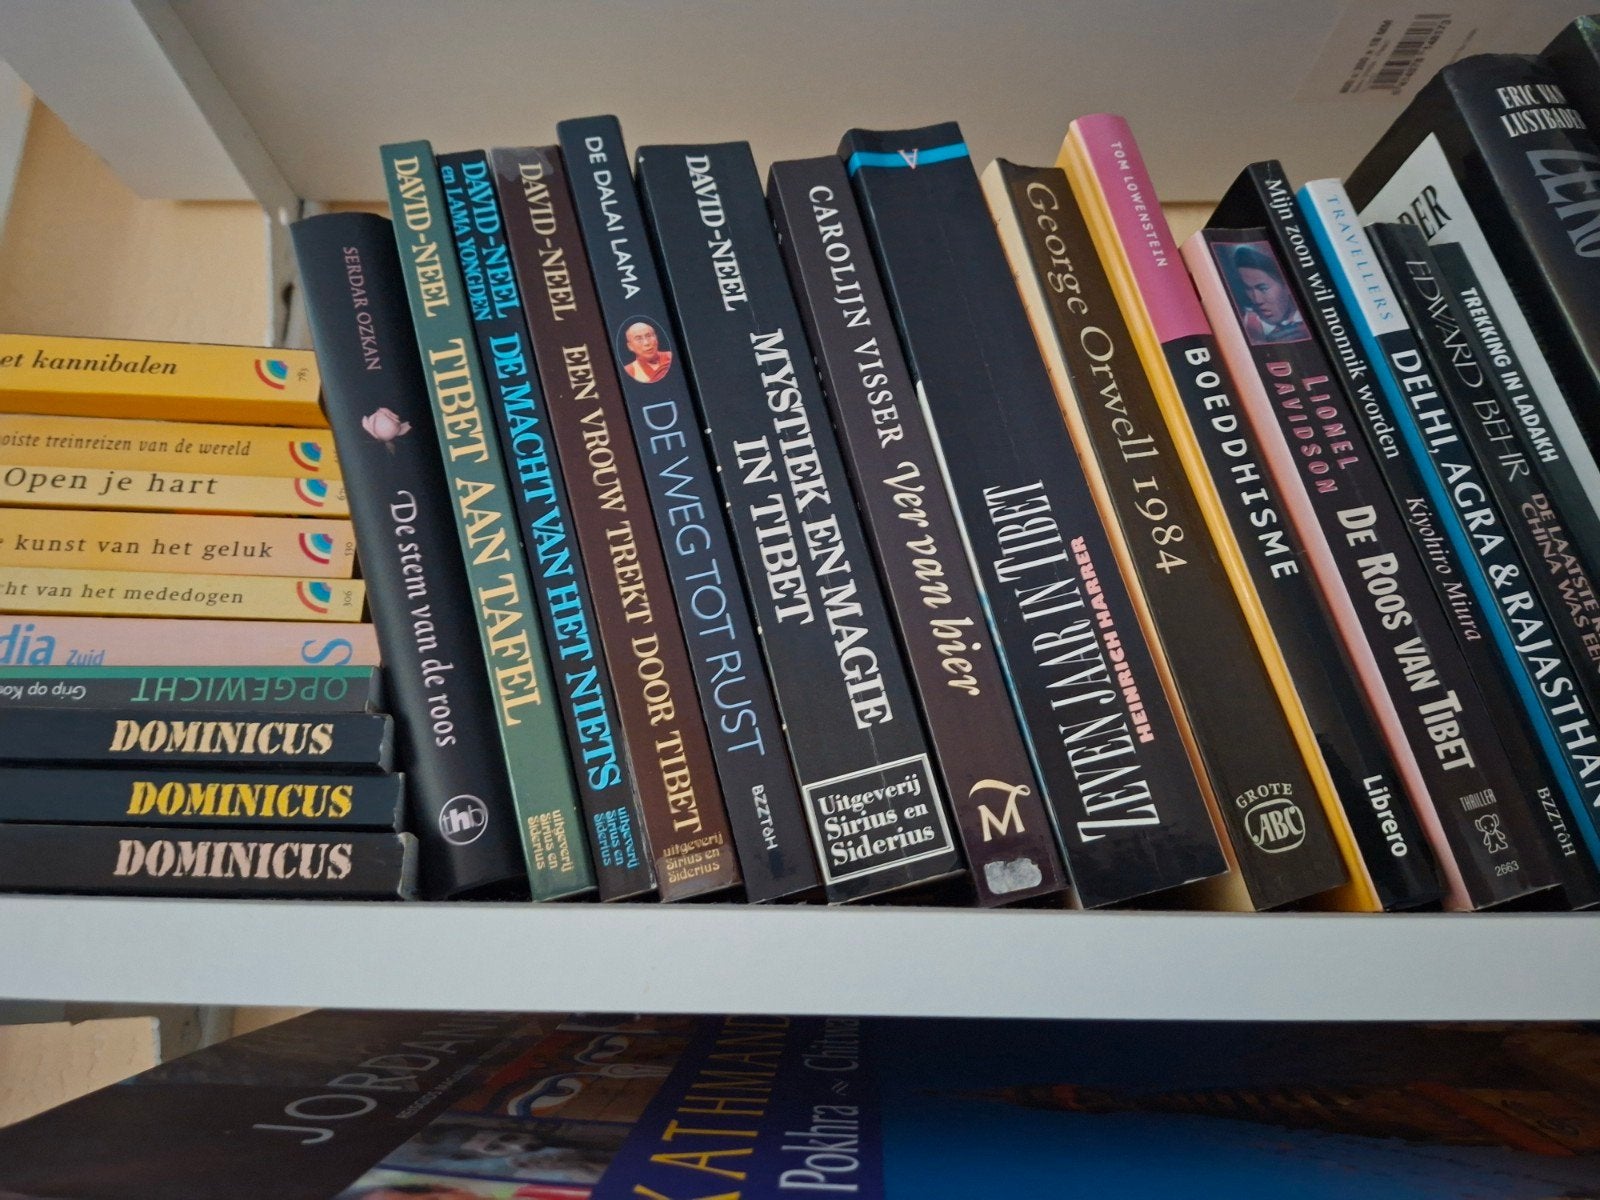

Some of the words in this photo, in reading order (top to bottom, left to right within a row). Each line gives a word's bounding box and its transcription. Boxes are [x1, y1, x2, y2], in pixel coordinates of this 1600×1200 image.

[1496, 84, 1541, 110] ERIC
[441, 166, 454, 185] en
[585, 136, 607, 164] DE
[446, 189, 470, 235] LAMA
[593, 170, 625, 233] DALAI
[685, 154, 748, 312] DAVID-NEEL
[1110, 140, 1130, 171] TOM
[1124, 175, 1167, 267] LOWENSTEIN
[393, 156, 450, 318] DAVID-NEEL
[462, 160, 520, 319] DAVID-NEEL
[518, 162, 577, 321] DAVID-NEEL
[610, 238, 641, 300] LAMA
[1325, 193, 1394, 322] TRAVELLERS
[343, 247, 368, 307] SERDAR
[356, 312, 382, 370] OZKAN
[459, 237, 493, 322] YONGDEN
[808, 185, 871, 328] CAROLIJN
[854, 337, 904, 449] VISSER
[1265, 178, 1293, 221] Mijn
[1286, 224, 1315, 268] zoon
[1307, 270, 1334, 309] wil
[1321, 306, 1365, 381] monnik
[1356, 385, 1400, 460] worden
[1460, 287, 1512, 368] TREKKING
[32, 350, 178, 375] kannibalen
[489, 332, 528, 379] DE
[562, 343, 599, 400] EEN
[1026, 182, 1090, 316] George
[1080, 325, 1160, 463] Orwell
[1132, 475, 1188, 575] 1984
[1406, 260, 1484, 389] EDWARD
[1473, 399, 1530, 482] BEHR
[1500, 370, 1524, 393] IN
[429, 339, 490, 463] TIBET
[642, 400, 686, 455] DE
[750, 328, 831, 513] MYSTIEK
[1266, 361, 1338, 494] DAVIDSON
[1302, 374, 1359, 470] LIONEL
[1511, 393, 1560, 463] LADAKH
[45, 433, 132, 452] treinreizen
[139, 440, 168, 454] van
[174, 438, 193, 454] de
[199, 441, 251, 457] wereld
[501, 382, 556, 503] MACHT
[580, 406, 627, 513] VROUW
[733, 435, 778, 485] IN
[1185, 347, 1299, 579] BOEDDHISME
[1391, 349, 1458, 455] DELHI,
[1441, 462, 1505, 556] AGRA
[1488, 563, 1519, 590] &
[4, 467, 88, 493] Open
[98, 470, 132, 496] je
[147, 473, 218, 496] hart
[390, 490, 418, 537] De
[658, 456, 712, 557] WEG
[15, 534, 87, 552] kunst
[97, 539, 140, 555] van
[152, 538, 192, 557] het
[201, 540, 274, 561] geluk
[455, 479, 511, 565] AAN
[532, 507, 573, 578] VAN
[802, 514, 851, 577] EN
[983, 479, 1069, 583] TIBET
[1531, 493, 1557, 521] DE
[1549, 525, 1600, 612] LAATSTE
[36, 585, 72, 598] van
[81, 583, 116, 599] het
[123, 587, 243, 605] mededogen
[401, 542, 427, 599] stem
[605, 520, 653, 624] TREKT
[750, 493, 815, 625] TIBET
[883, 461, 929, 528] Ver
[906, 534, 952, 609] van
[929, 616, 982, 697] hier
[1071, 535, 1115, 629] HARRER
[1406, 497, 1452, 575] Kiyohiro
[1443, 582, 1482, 642] Miura
[1521, 502, 1562, 575] CHINA
[1558, 578, 1590, 628] WAS
[410, 606, 436, 654] van
[546, 580, 594, 661] HET
[685, 558, 736, 640] TOT
[1015, 577, 1085, 622] IN
[1336, 505, 1377, 547] DE
[1357, 552, 1413, 630] ROOS
[1394, 636, 1441, 692] VAN
[66, 649, 106, 668] Zuid
[421, 658, 454, 688] de
[478, 573, 541, 727] TAFEL
[631, 632, 675, 726] DOOR
[820, 579, 893, 730] MAGIE
[1032, 619, 1117, 711] JAAR
[28, 682, 48, 696] op
[52, 681, 87, 699] Grip
[131, 676, 348, 702] OPGEWICHT
[427, 694, 455, 748] roos
[705, 650, 765, 757] RUST
[1105, 630, 1155, 744] HEINRICH
[109, 719, 334, 755] DOMINICUS
[566, 665, 622, 792] NIETS
[127, 781, 354, 818] DOMINICUS
[655, 730, 702, 834] TIBET
[818, 774, 921, 815] Uitgeverij
[1077, 712, 1160, 844] ZEVEN
[1235, 782, 1293, 809] GROTE
[1459, 788, 1497, 812] THRILLER
[527, 817, 546, 871] Siderius
[539, 812, 555, 851] Sirius
[547, 852, 558, 870] en
[552, 809, 575, 873] uitgeverij
[593, 813, 612, 867] Siderius
[606, 810, 621, 848] Sirius
[614, 849, 625, 866] en
[617, 806, 640, 870] uitgeverij
[662, 832, 724, 858] uitgeverij
[824, 808, 897, 841] Sirius
[904, 803, 929, 820] en
[830, 825, 935, 866] Siderius
[1252, 805, 1304, 847] ABC
[1362, 774, 1408, 857] Librero
[113, 839, 353, 879] DOMINICUS
[665, 850, 702, 871] Sirius
[704, 848, 721, 861] en
[667, 862, 720, 884] Siderius
[1494, 860, 1519, 877] 2663
[778, 1104, 859, 1192] Pokhra
